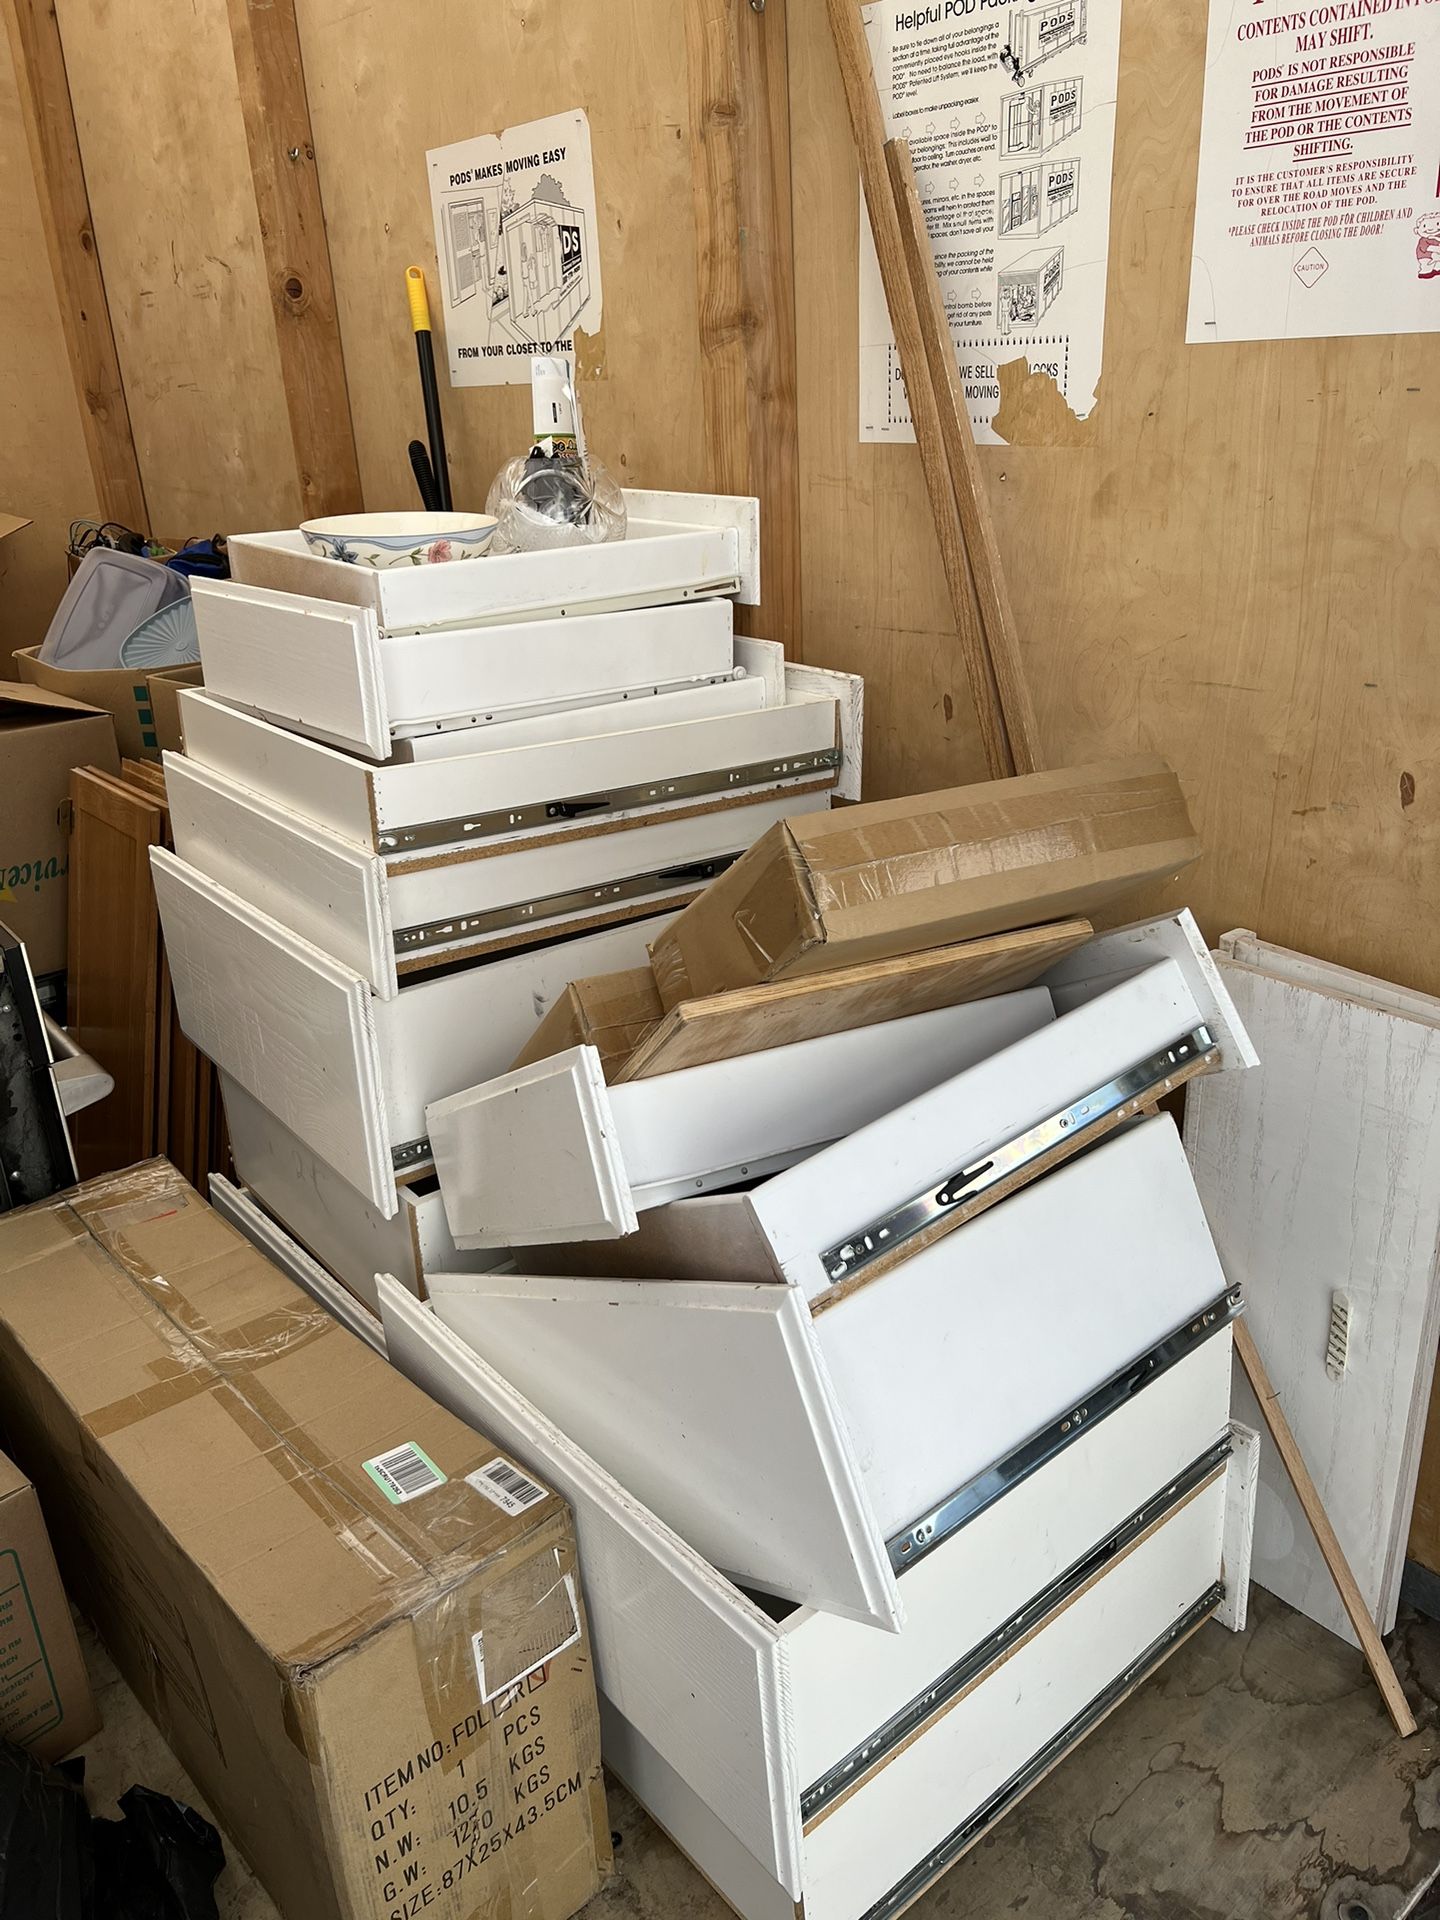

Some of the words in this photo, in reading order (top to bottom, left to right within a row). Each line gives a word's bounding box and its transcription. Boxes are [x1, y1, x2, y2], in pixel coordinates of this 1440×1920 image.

[896, 4, 941, 31] Helpful
[945, 0, 976, 19] POD
[1040, 11, 1073, 31] PODS
[1237, 11, 1306, 41] CONTENTS
[1309, 0, 1392, 29] CONTAINED
[923, 38, 938, 46] down
[952, 30, 964, 40] your
[964, 23, 994, 37] belongings
[955, 36, 984, 47] advantage
[1295, 32, 1327, 53] MAY
[1329, 22, 1374, 46] SHIFT.
[892, 59, 924, 71] conveniently
[917, 67, 931, 75] need
[939, 61, 961, 71] balance
[962, 57, 970, 65] the
[1288, 63, 1299, 76] IS
[1301, 58, 1327, 74] NOT
[1329, 42, 1415, 68] RESPONSIBLE
[1255, 88, 1278, 102] FOR
[1281, 78, 1333, 98] DAMAGE
[1336, 65, 1408, 88] RESULTING
[1051, 90, 1076, 106] PODS
[1251, 107, 1285, 123] FROM
[1288, 101, 1312, 117] THE
[1315, 90, 1388, 112] MOVEMENT
[1391, 87, 1409, 100] OF
[933, 133, 949, 142] space
[967, 127, 975, 135] the
[1245, 130, 1268, 144] THE
[1270, 125, 1294, 140] POD
[1297, 123, 1314, 135] OR
[1317, 118, 1342, 132] THE
[1345, 108, 1412, 128] CONTENTS
[1293, 138, 1354, 157] SHIFTING.
[475, 163, 502, 180] MAKES
[506, 154, 540, 173] MOVING
[543, 147, 566, 164] EASY
[1236, 177, 1244, 185] IT
[1247, 175, 1255, 184] IS
[1257, 173, 1274, 182] THE
[1277, 165, 1333, 180] CUSTOMER'S
[1336, 154, 1414, 172] RESPONSIBILITY
[1049, 171, 1074, 187] PODS
[1232, 189, 1242, 197] TO
[1245, 184, 1278, 196] ENSURE
[1281, 180, 1304, 191] THAT
[1306, 178, 1323, 188] ALL
[1327, 174, 1355, 185] ITEMS
[1358, 171, 1377, 181] ARE
[1380, 166, 1417, 179] SECURE
[1238, 199, 1254, 208] FOR
[1257, 196, 1280, 205] OVER
[1283, 193, 1300, 202] THE
[1303, 189, 1328, 200] ROAD
[1330, 185, 1362, 196] MOVES
[1365, 183, 1384, 192] AND
[1388, 180, 1407, 190] THE
[1261, 202, 1317, 216] RELOCATION
[1320, 201, 1333, 210] OF
[1336, 198, 1353, 208] THE
[1356, 195, 1377, 205] POD.
[1257, 222, 1280, 233] CHECK
[1282, 219, 1306, 231] INSIDE
[1308, 217, 1322, 228] THE
[1323, 216, 1338, 227] POD
[1340, 213, 1354, 225] FOR
[1356, 209, 1395, 223] CHILDREN
[1397, 207, 1412, 218] AND
[563, 230, 579, 254] DS
[1250, 234, 1280, 247] ANIMALS
[1281, 231, 1309, 244] BEFORE
[1311, 228, 1340, 240] CLOSING
[1344, 227, 1358, 237] THE
[1360, 224, 1384, 236] DOOR!
[1297, 264, 1324, 272] CAUTION
[458, 347, 479, 358] FROM
[481, 346, 504, 357] YOUR
[506, 343, 537, 355] CLOSET
[540, 341, 552, 352] TO
[556, 340, 572, 351] THE
[959, 366, 973, 379] WE
[975, 365, 995, 379] SELL
[965, 386, 999, 398] MOVING
[371, 1799, 416, 1841] QTY:
[456, 1759, 465, 1778] 1
[504, 1706, 541, 1746] PCS
[364, 1761, 414, 1812] ITEM
[375, 1831, 420, 1875] N.W:
[448, 1778, 488, 1820] 10.5
[509, 1736, 546, 1775] KGS
[384, 1861, 427, 1903] G.W:
[514, 1765, 551, 1804] KGS
